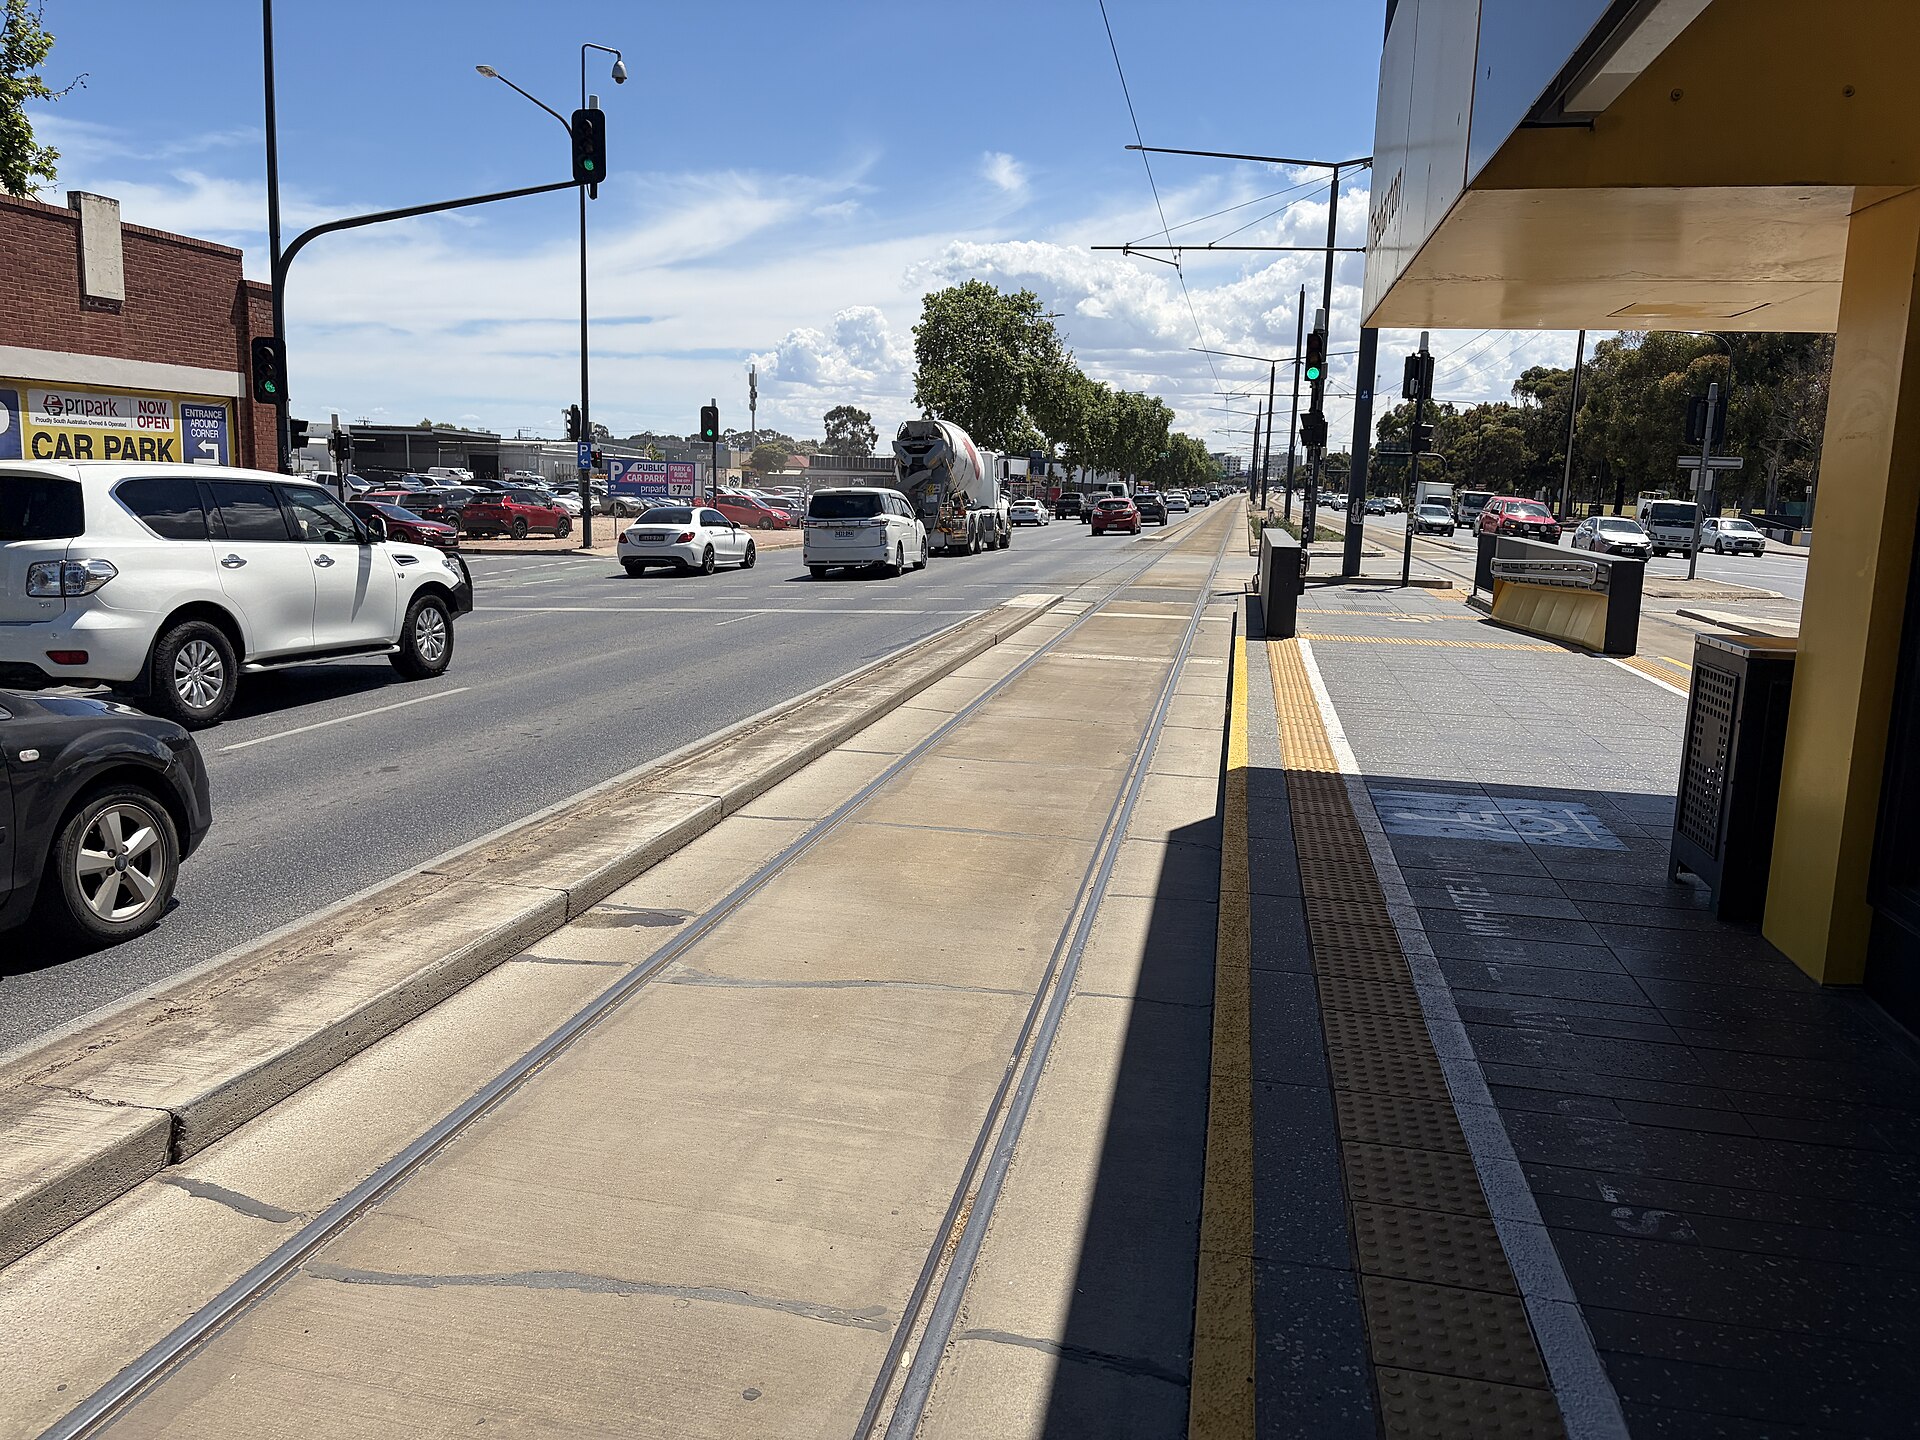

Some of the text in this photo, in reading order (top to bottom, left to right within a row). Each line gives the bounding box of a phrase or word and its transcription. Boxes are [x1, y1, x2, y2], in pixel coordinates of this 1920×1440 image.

[65, 398, 118, 417] pripark
[138, 400, 167, 415] NOW
[185, 408, 222, 419] ENTRANCE
[35, 416, 52, 425] Proudly
[67, 418, 88, 426] Australian
[108, 420, 127, 428] Operated
[137, 416, 170, 429] OPEN
[190, 419, 219, 429] AROUND
[191, 428, 219, 438] CORNER
[31, 431, 174, 462] CAR PARK
[580, 444, 589, 456] P
[611, 461, 623, 481] P
[637, 463, 665, 472] PUBLIC
[626, 473, 665, 482] CAR PARK
[641, 485, 666, 493] pripark
[673, 485, 692, 494] $7.00
[1446, 885, 1512, 936] WHITE
